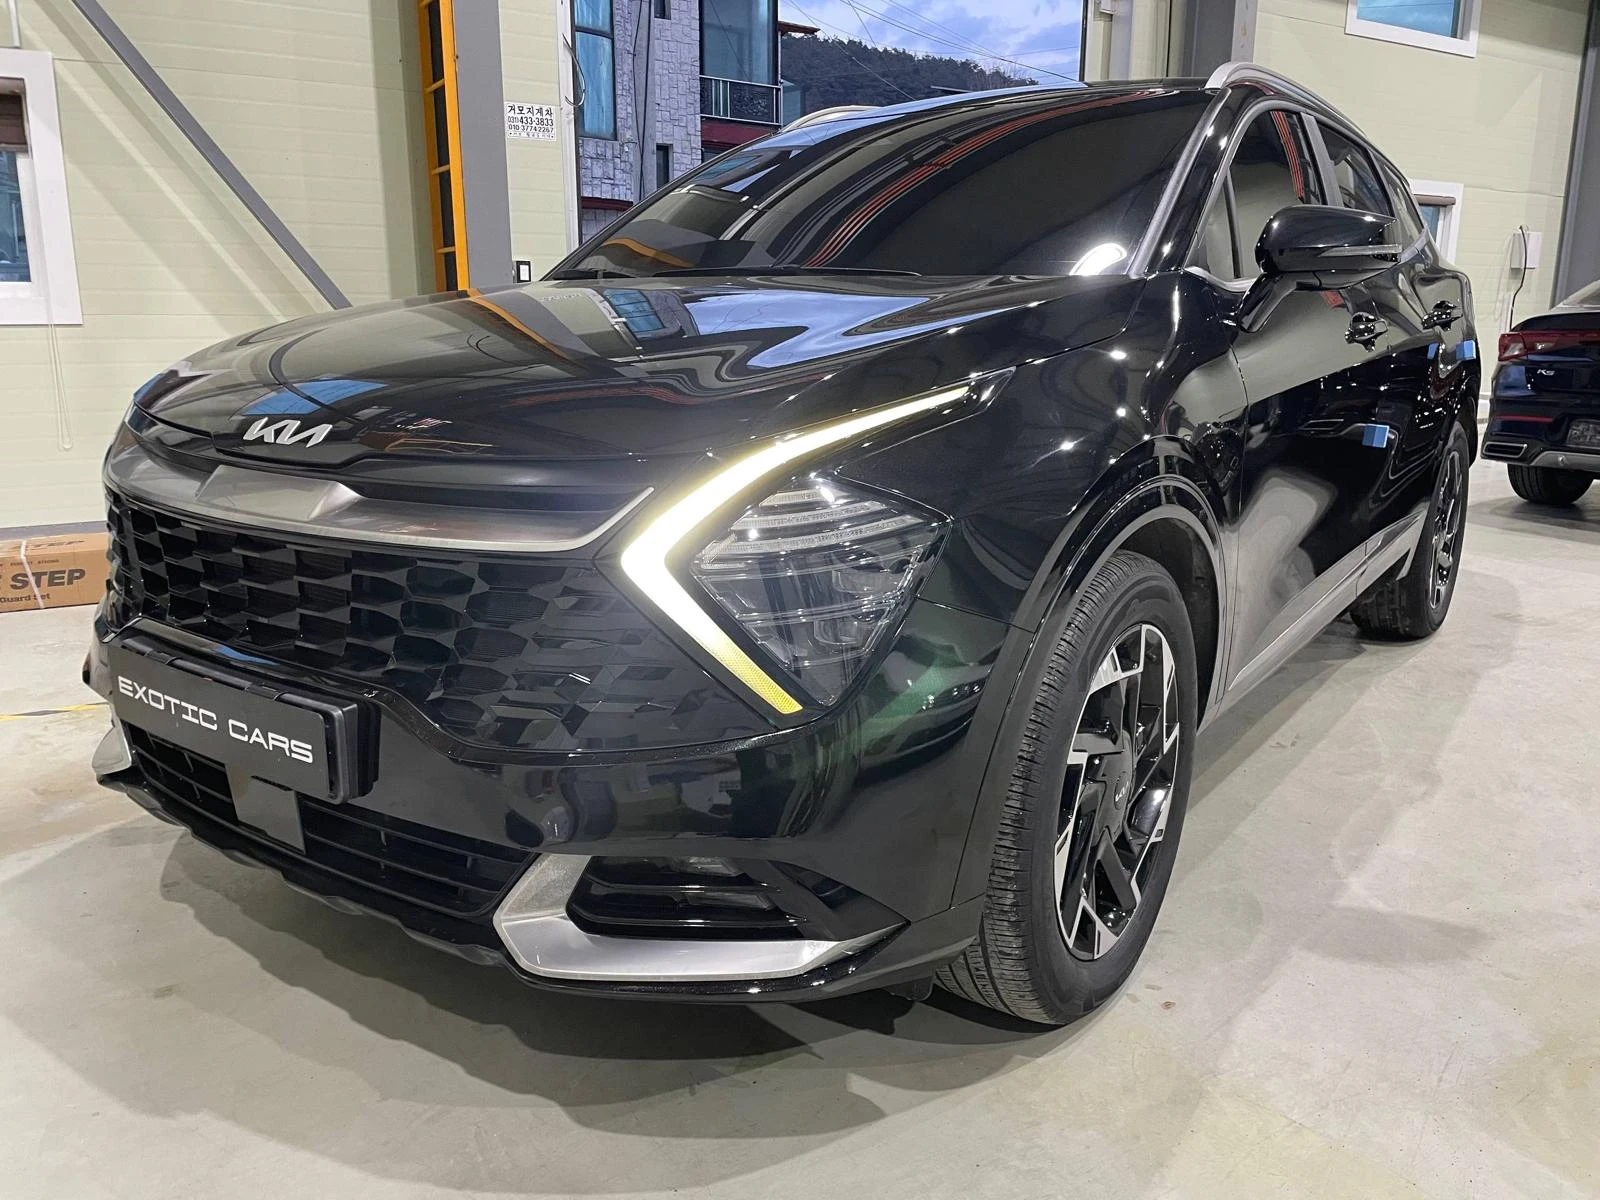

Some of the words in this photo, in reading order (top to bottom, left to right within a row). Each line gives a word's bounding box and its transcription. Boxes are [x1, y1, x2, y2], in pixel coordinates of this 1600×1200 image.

[508, 104, 553, 117] 거모지게차
[243, 416, 333, 448] KIA
[10, 568, 86, 590] STEP
[118, 675, 218, 731] EXOTIC
[228, 718, 313, 764] CARS
